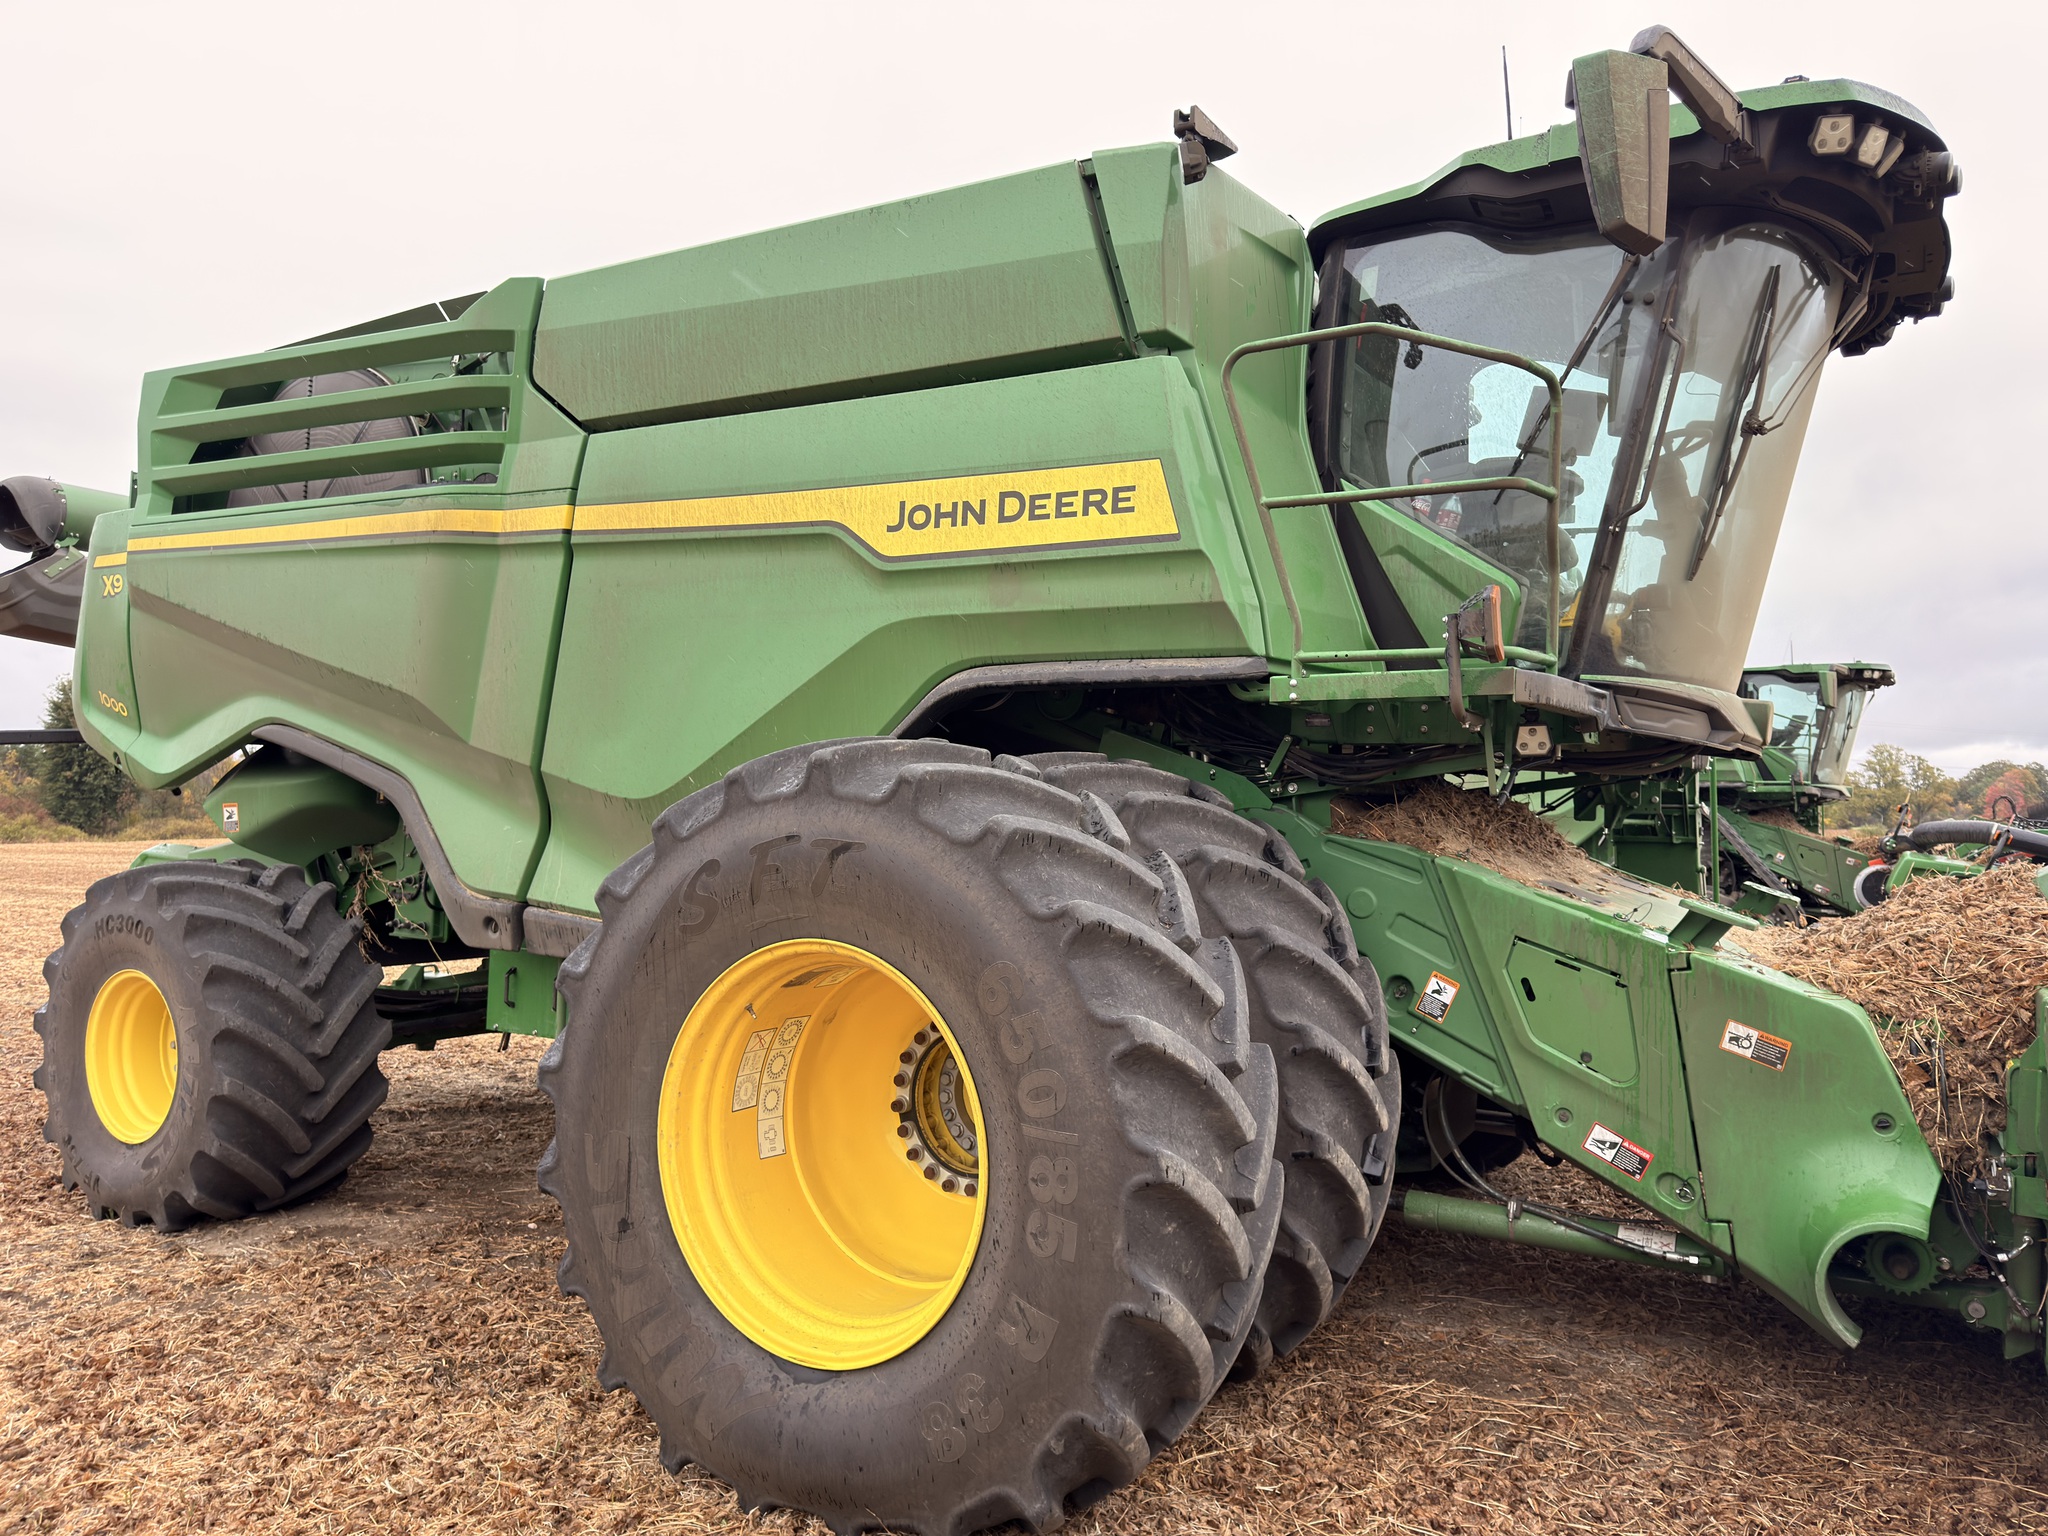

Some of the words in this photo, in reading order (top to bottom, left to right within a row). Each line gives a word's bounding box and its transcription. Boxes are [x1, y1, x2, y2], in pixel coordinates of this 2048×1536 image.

[886, 498, 986, 533] JOHN
[997, 485, 1136, 524] DEERE
[102, 574, 123, 597] X9
[98, 690, 128, 717] 1000
[94, 914, 154, 946] HC3000
[977, 960, 1080, 1263] 650/85
[1629, 1144, 1651, 1160] DANGER
